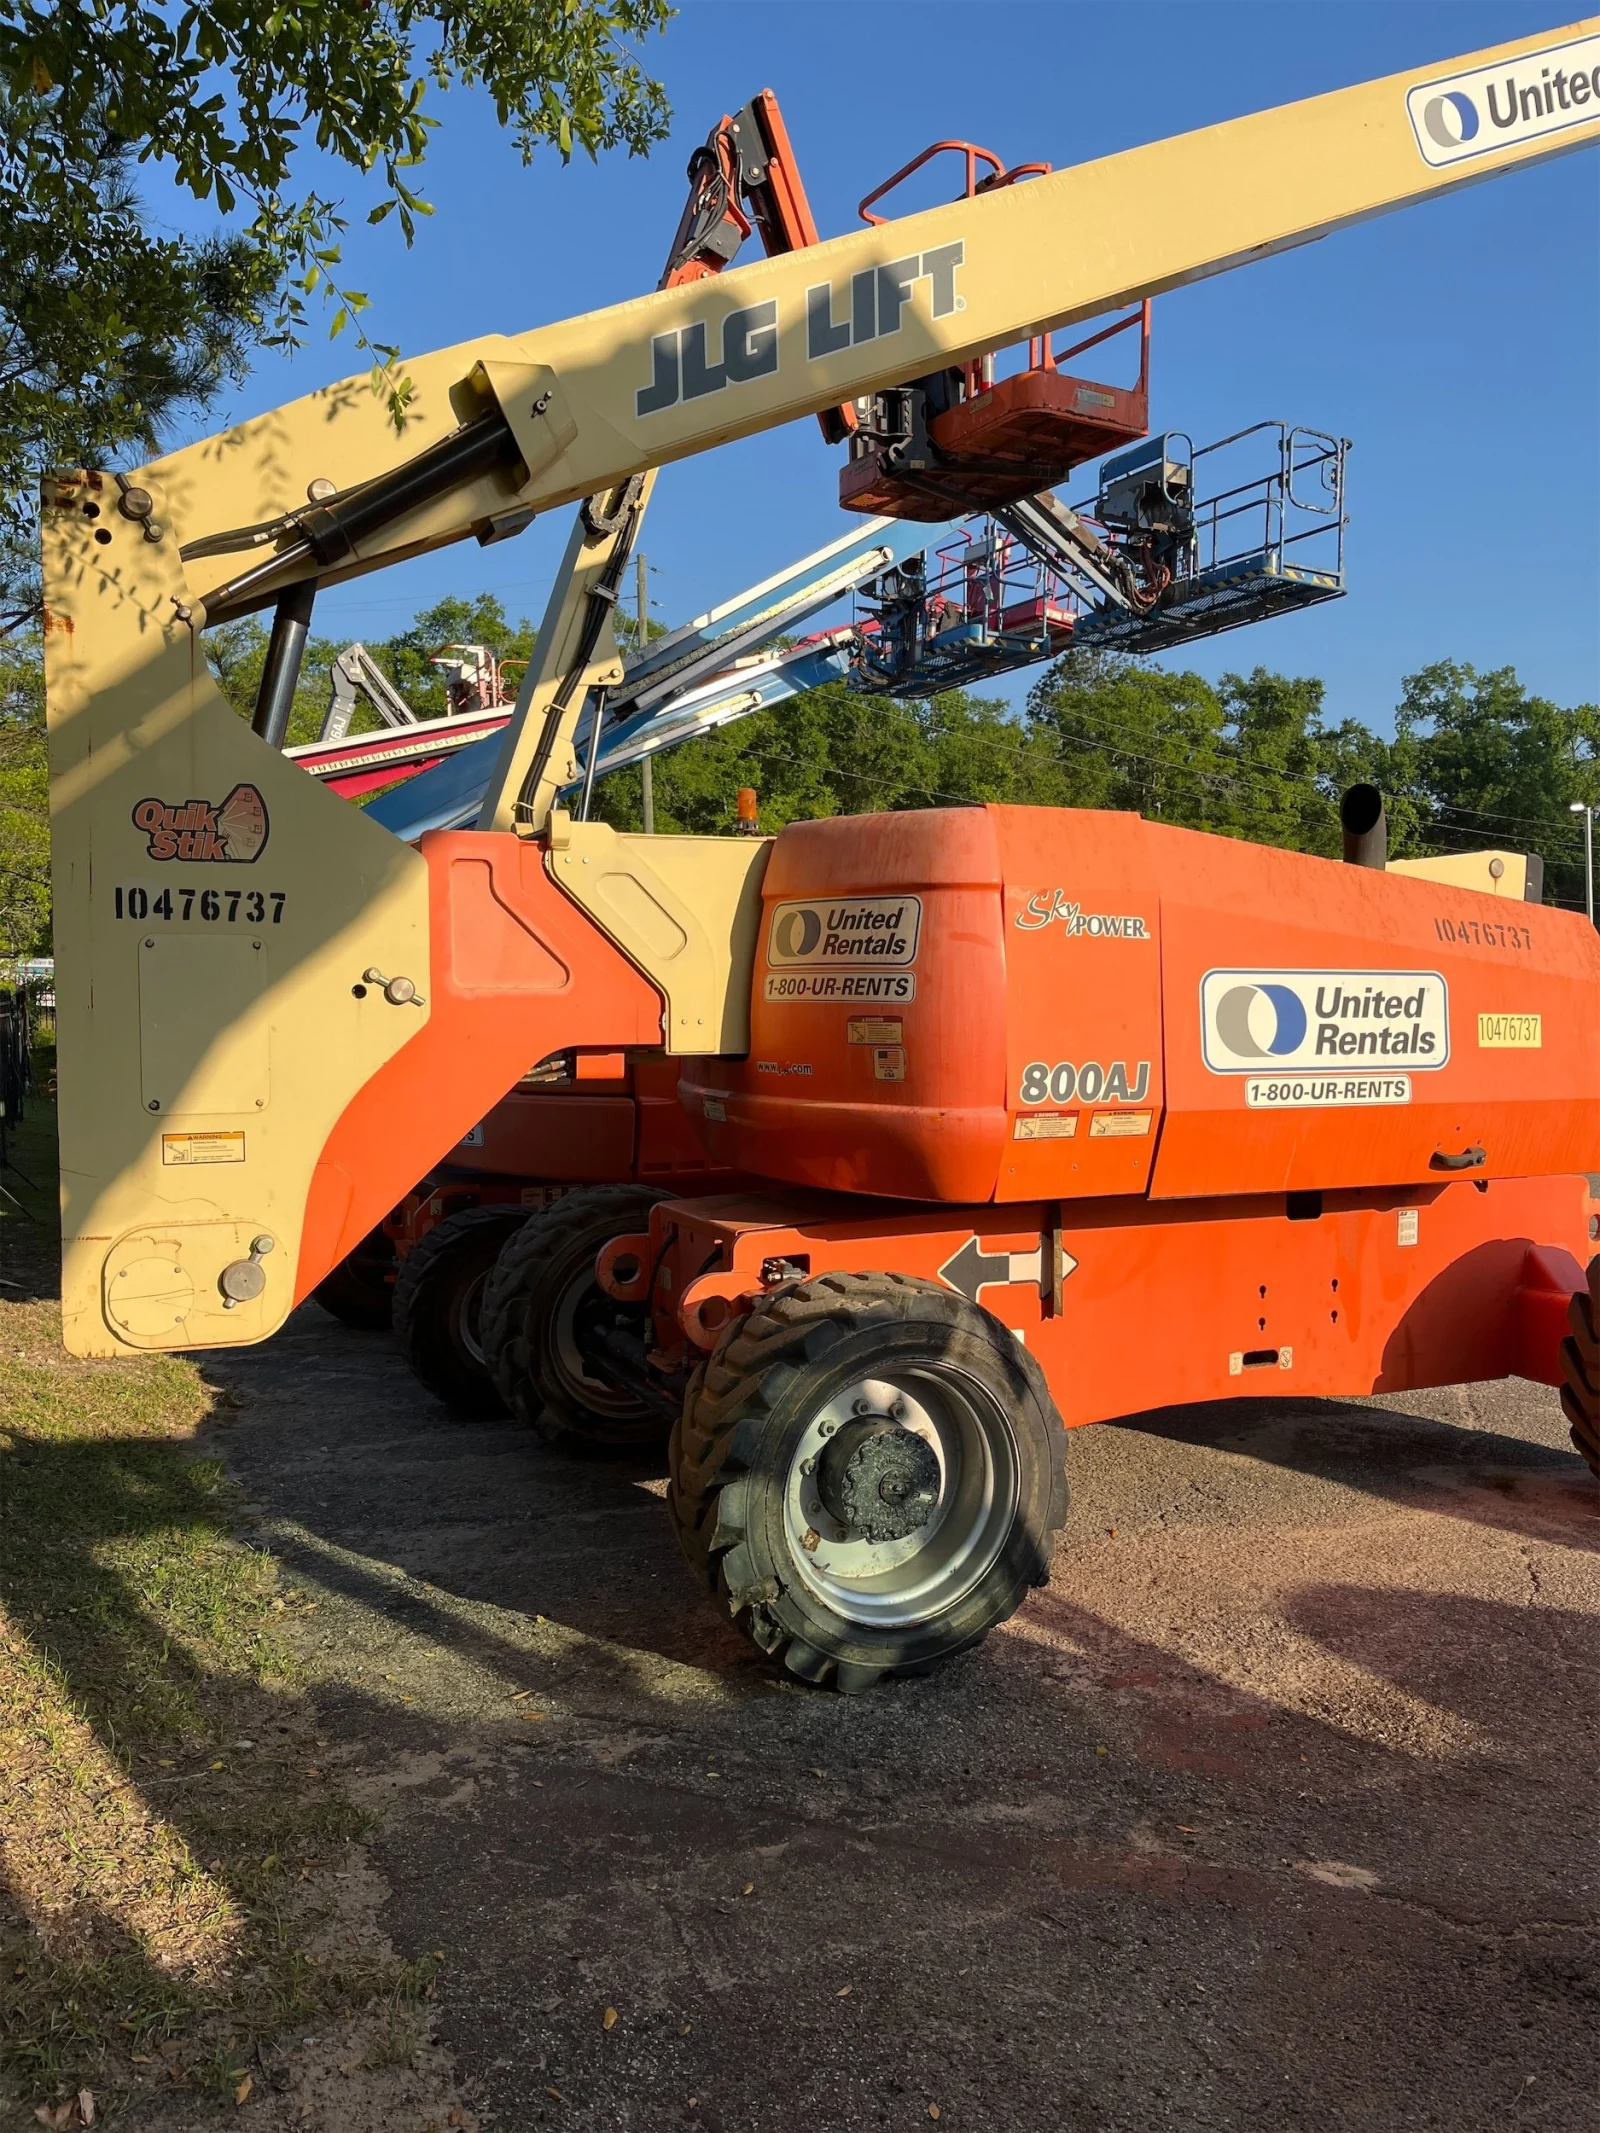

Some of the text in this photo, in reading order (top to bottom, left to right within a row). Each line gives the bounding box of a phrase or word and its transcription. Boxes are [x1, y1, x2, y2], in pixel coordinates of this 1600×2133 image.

[635, 238, 965, 417] JLG LIFT
[135, 801, 220, 834] Quik
[150, 830, 229, 860] Stik
[115, 886, 286, 923] 10476737
[826, 907, 904, 931] United
[822, 932, 907, 956] Rentals
[1434, 917, 1532, 951] 10476737
[768, 977, 909, 997] 1-800-UR-RENTS
[1315, 987, 1426, 1019] United
[1315, 1023, 1436, 1056] Rentals
[1479, 1016, 1539, 1041] 10476737
[1021, 1063, 1149, 1103] 800AJ
[1250, 1080, 1406, 1102] 1-800-UR-RENTS
